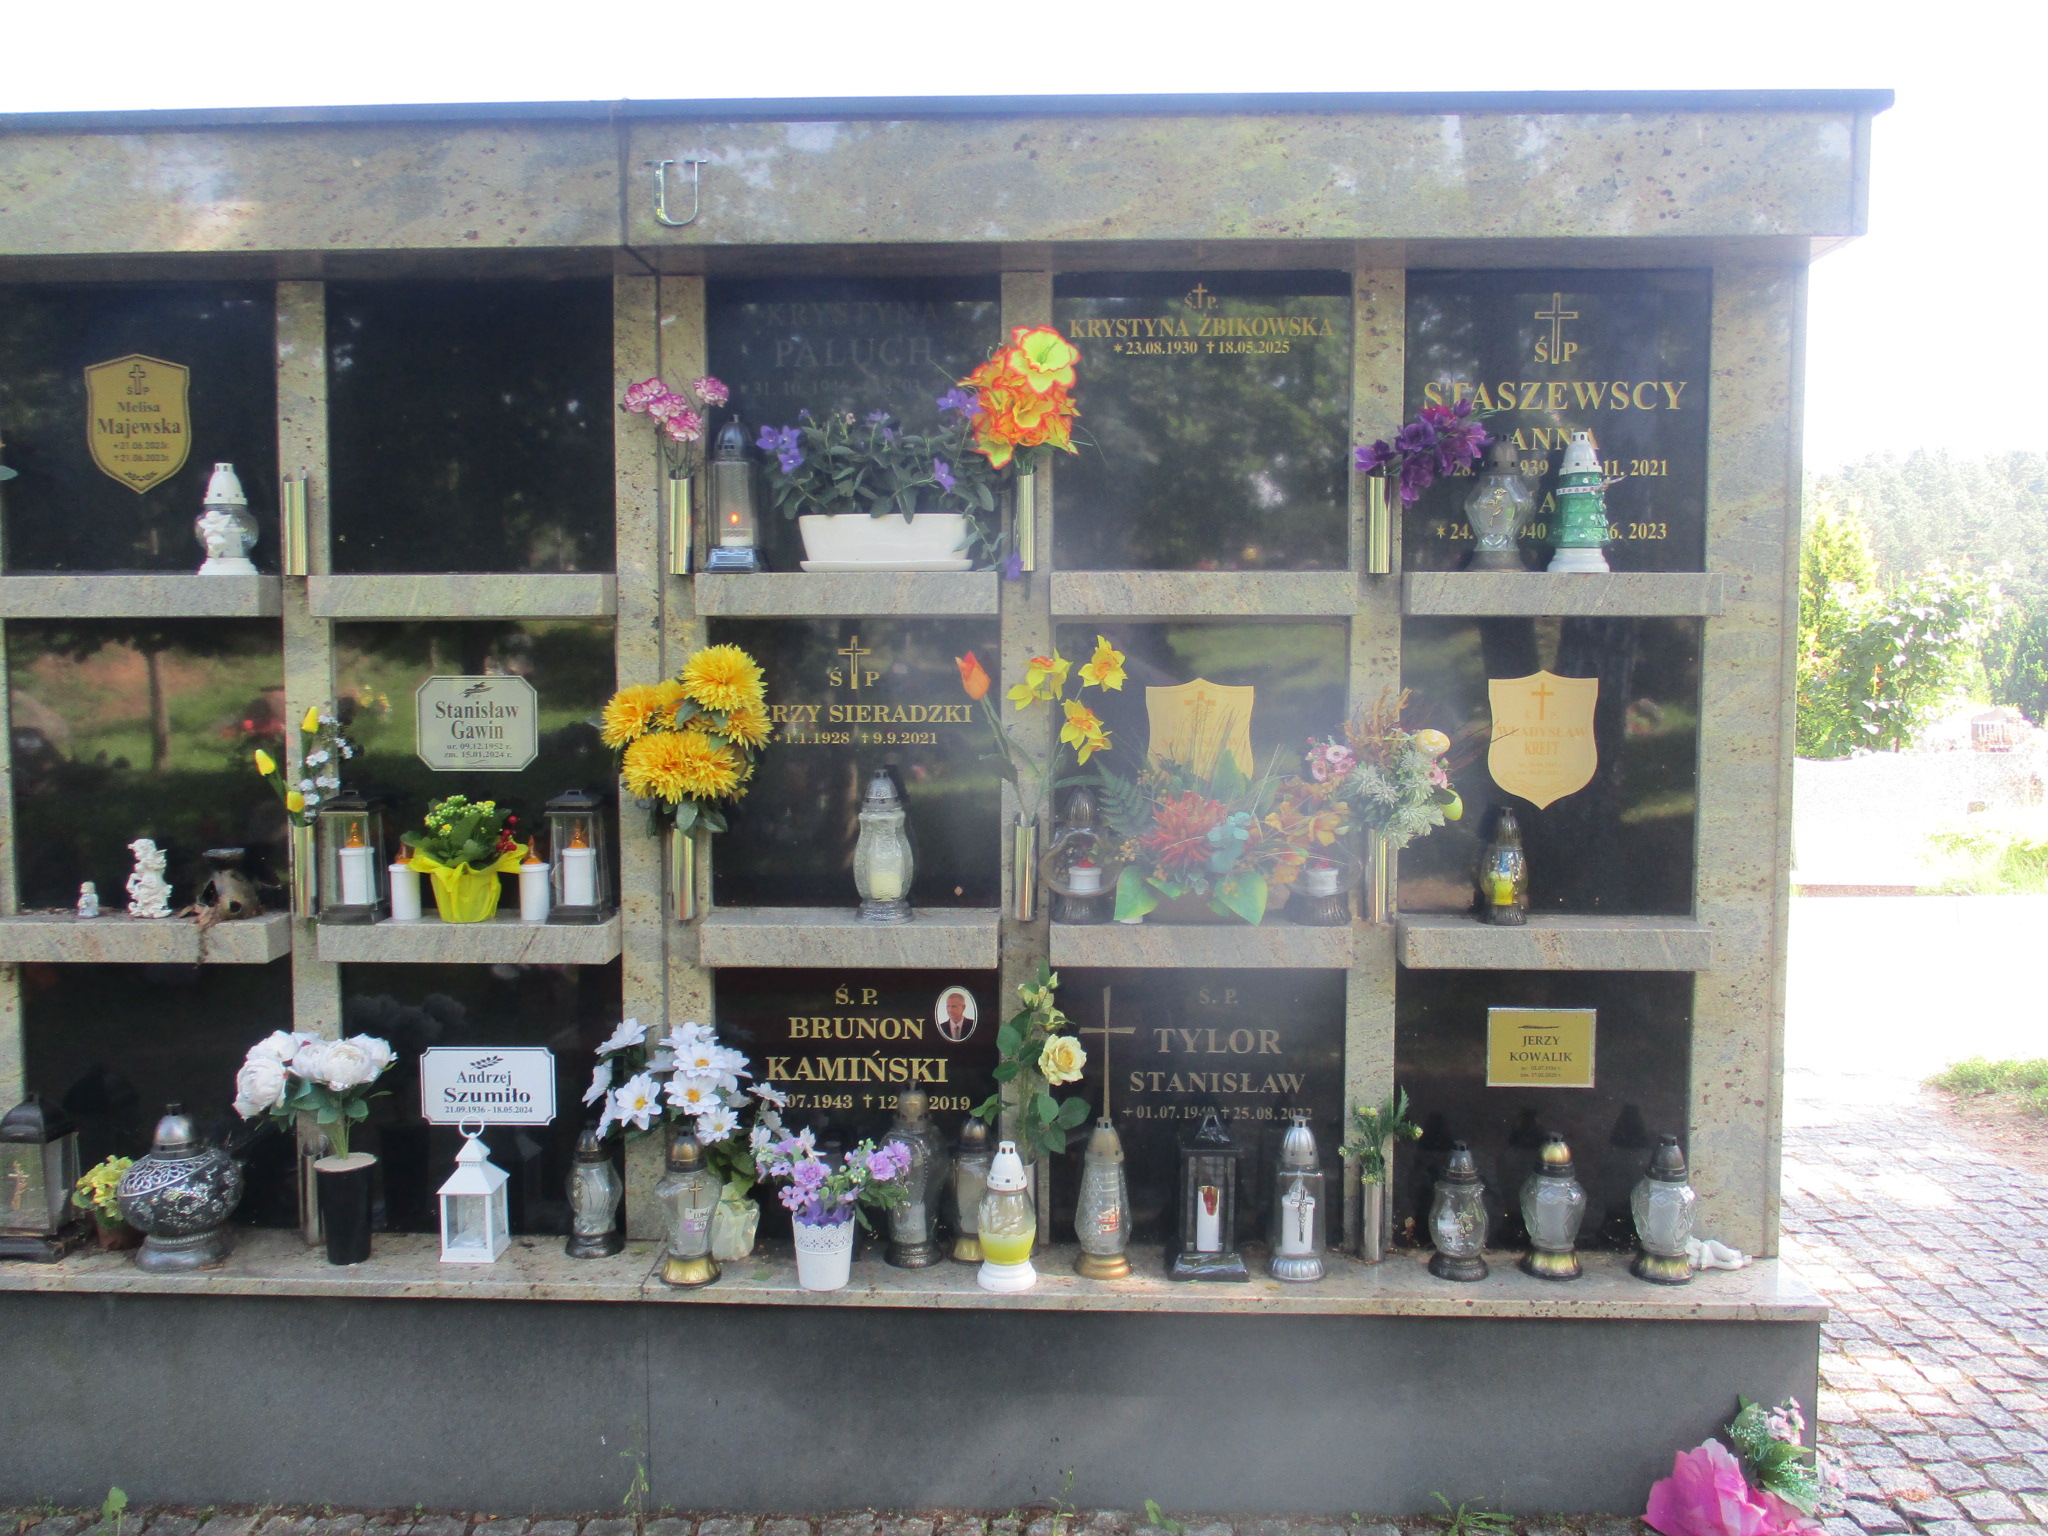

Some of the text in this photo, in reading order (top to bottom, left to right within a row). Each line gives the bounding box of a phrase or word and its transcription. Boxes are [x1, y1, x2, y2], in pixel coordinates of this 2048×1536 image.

[1069, 313, 1334, 338] KRYSTYNA ŻBIKOWSKA
[775, 336, 933, 368] PALUCH
[1563, 342, 1578, 362] P
[1424, 381, 1688, 410] STASZEWSCY
[118, 402, 160, 413] Melisa
[97, 418, 181, 438] Majewska
[1520, 459, 1549, 477] 939
[1630, 459, 1668, 476] 2021
[1450, 523, 1474, 539] 24.
[1628, 522, 1667, 539] 2023
[865, 671, 880, 687] P
[435, 700, 519, 719] Stanisław
[768, 704, 973, 723] RZY SIERADZKI
[451, 720, 504, 740] Gawin
[873, 732, 937, 744] 9.9.2021
[835, 983, 879, 1005] Ś. P.
[788, 1017, 925, 1040] BRUNON
[1153, 1028, 1283, 1054] TYLOR
[1522, 1035, 1561, 1047] JERZY
[765, 1050, 949, 1083] KAMIŃSKI
[1509, 1052, 1573, 1062] KOWALIK
[456, 1070, 511, 1087] Andrzej
[1129, 1071, 1306, 1093] STANISŁAW
[444, 1087, 531, 1103] Szumiło
